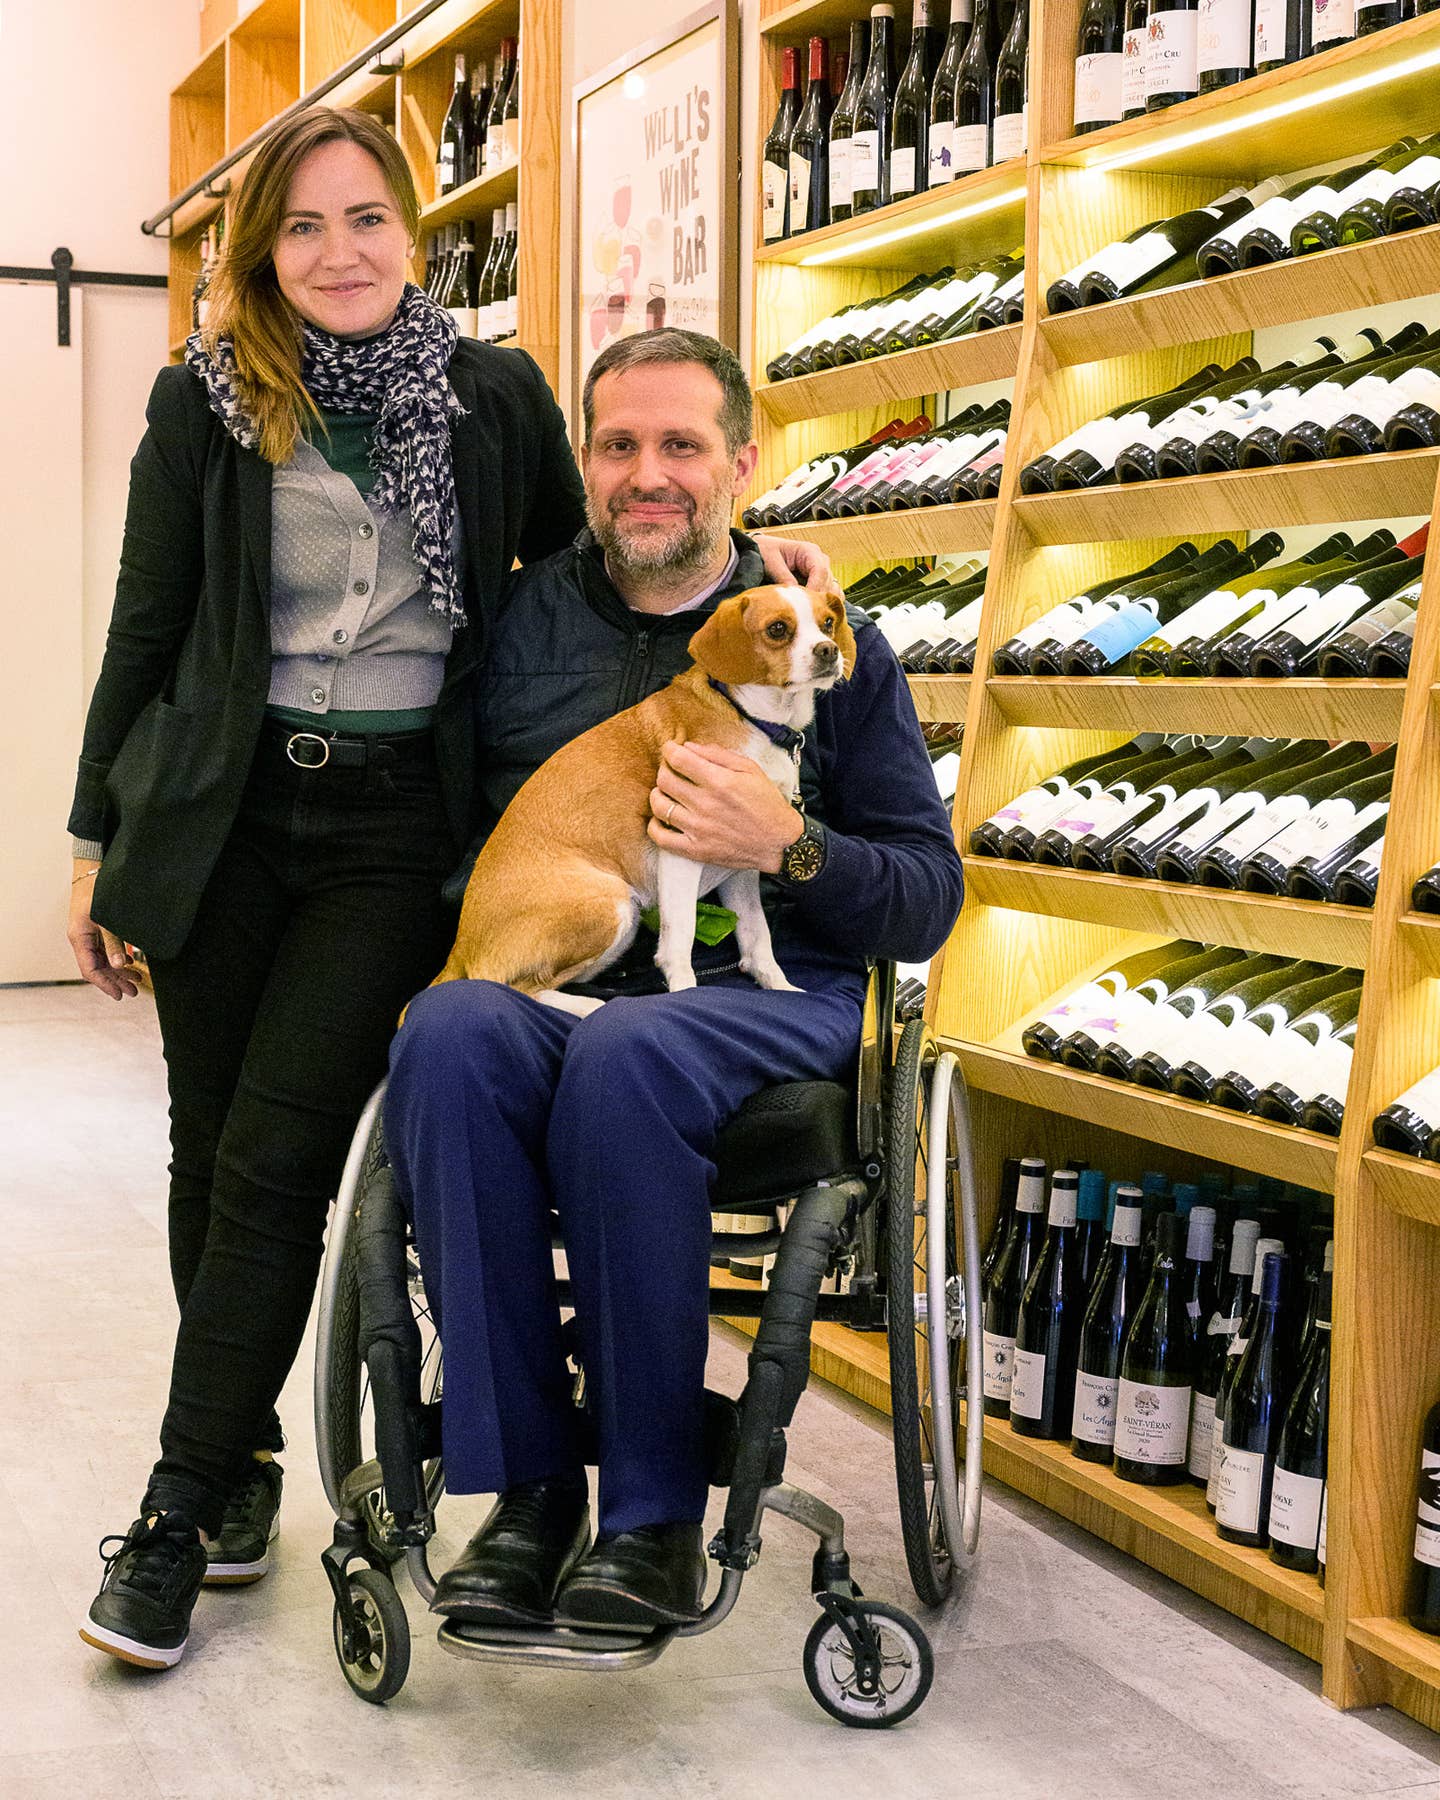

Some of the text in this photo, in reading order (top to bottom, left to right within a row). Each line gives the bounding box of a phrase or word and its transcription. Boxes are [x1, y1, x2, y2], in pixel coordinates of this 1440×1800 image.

[644, 85, 710, 160] WILLI'S
[659, 147, 700, 221] WINE
[673, 215, 707, 286] BAR
